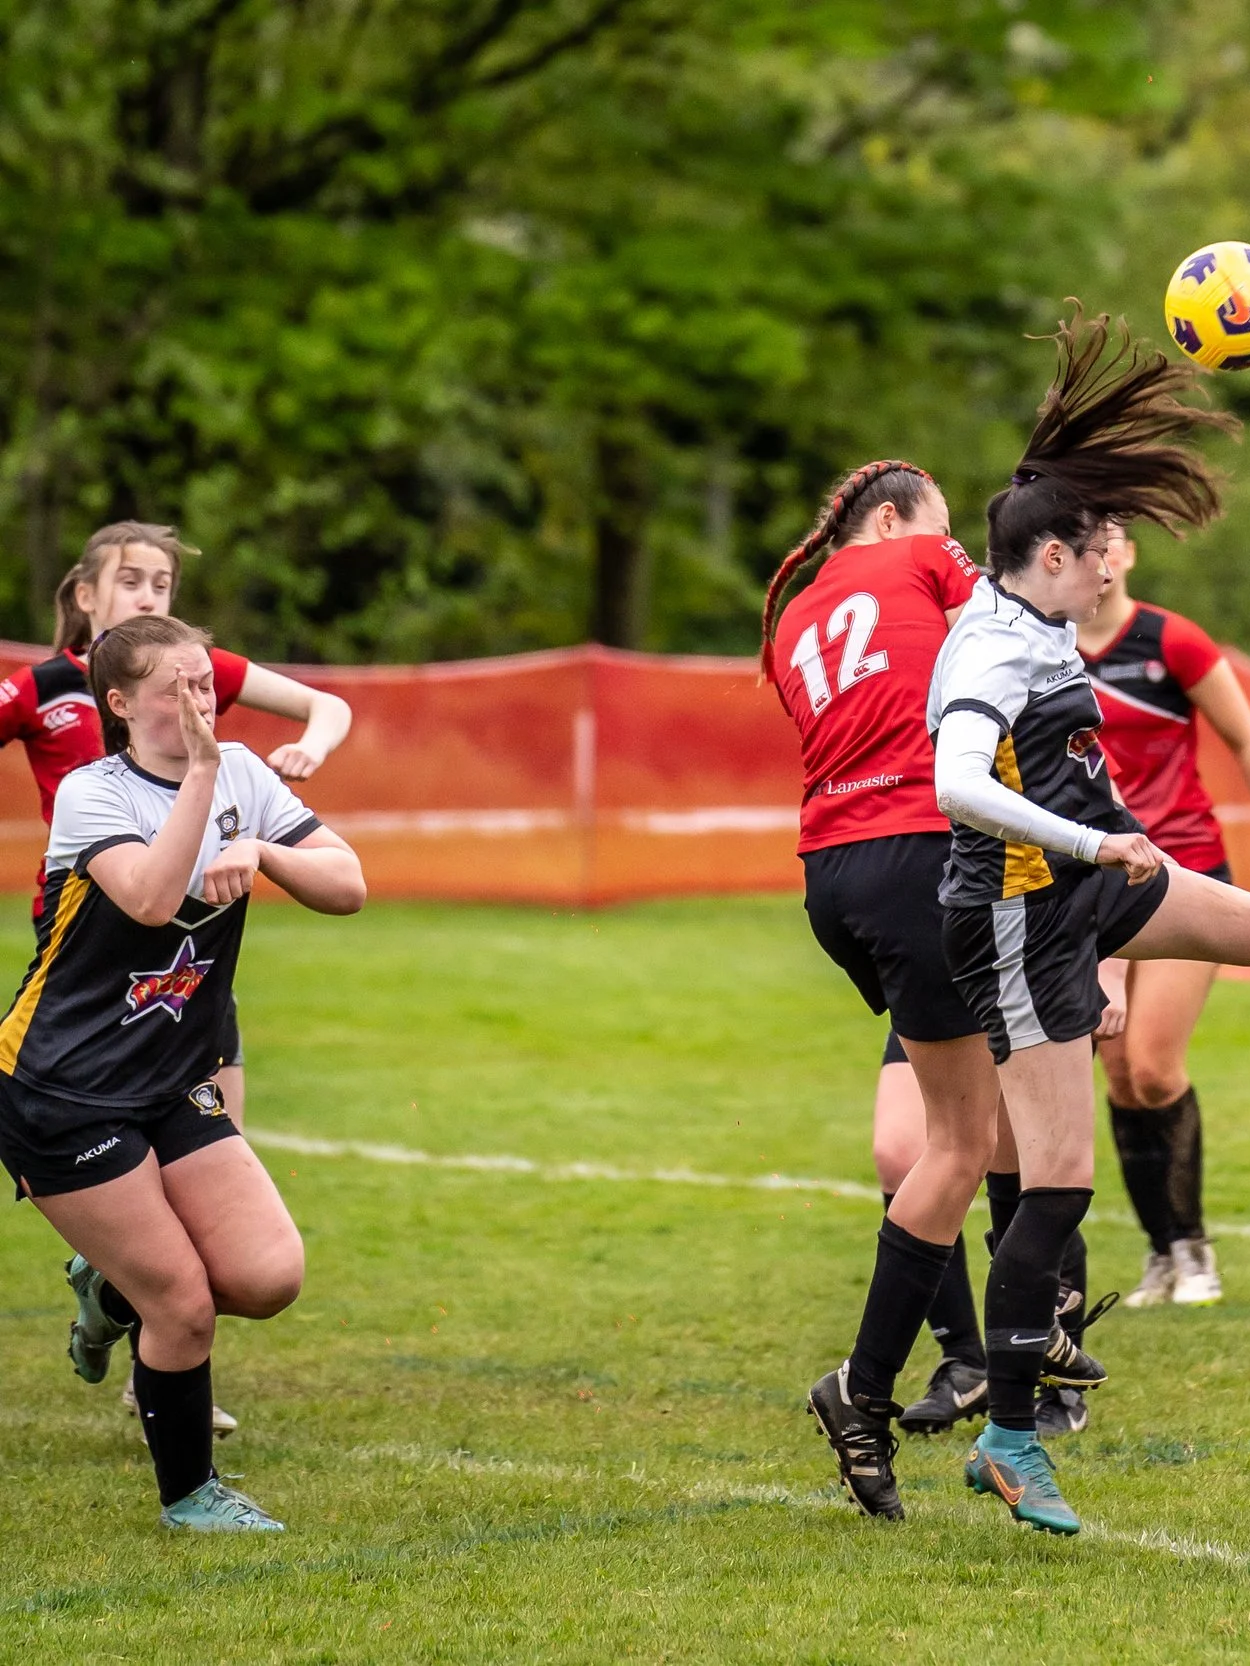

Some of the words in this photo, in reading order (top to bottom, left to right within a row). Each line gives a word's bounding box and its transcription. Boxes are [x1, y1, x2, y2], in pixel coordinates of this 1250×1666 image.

[790, 591, 889, 717] 12
[1046, 668, 1073, 685] AKUMA
[827, 773, 904, 795] Lancaster
[75, 1136, 121, 1165] AKUMA
